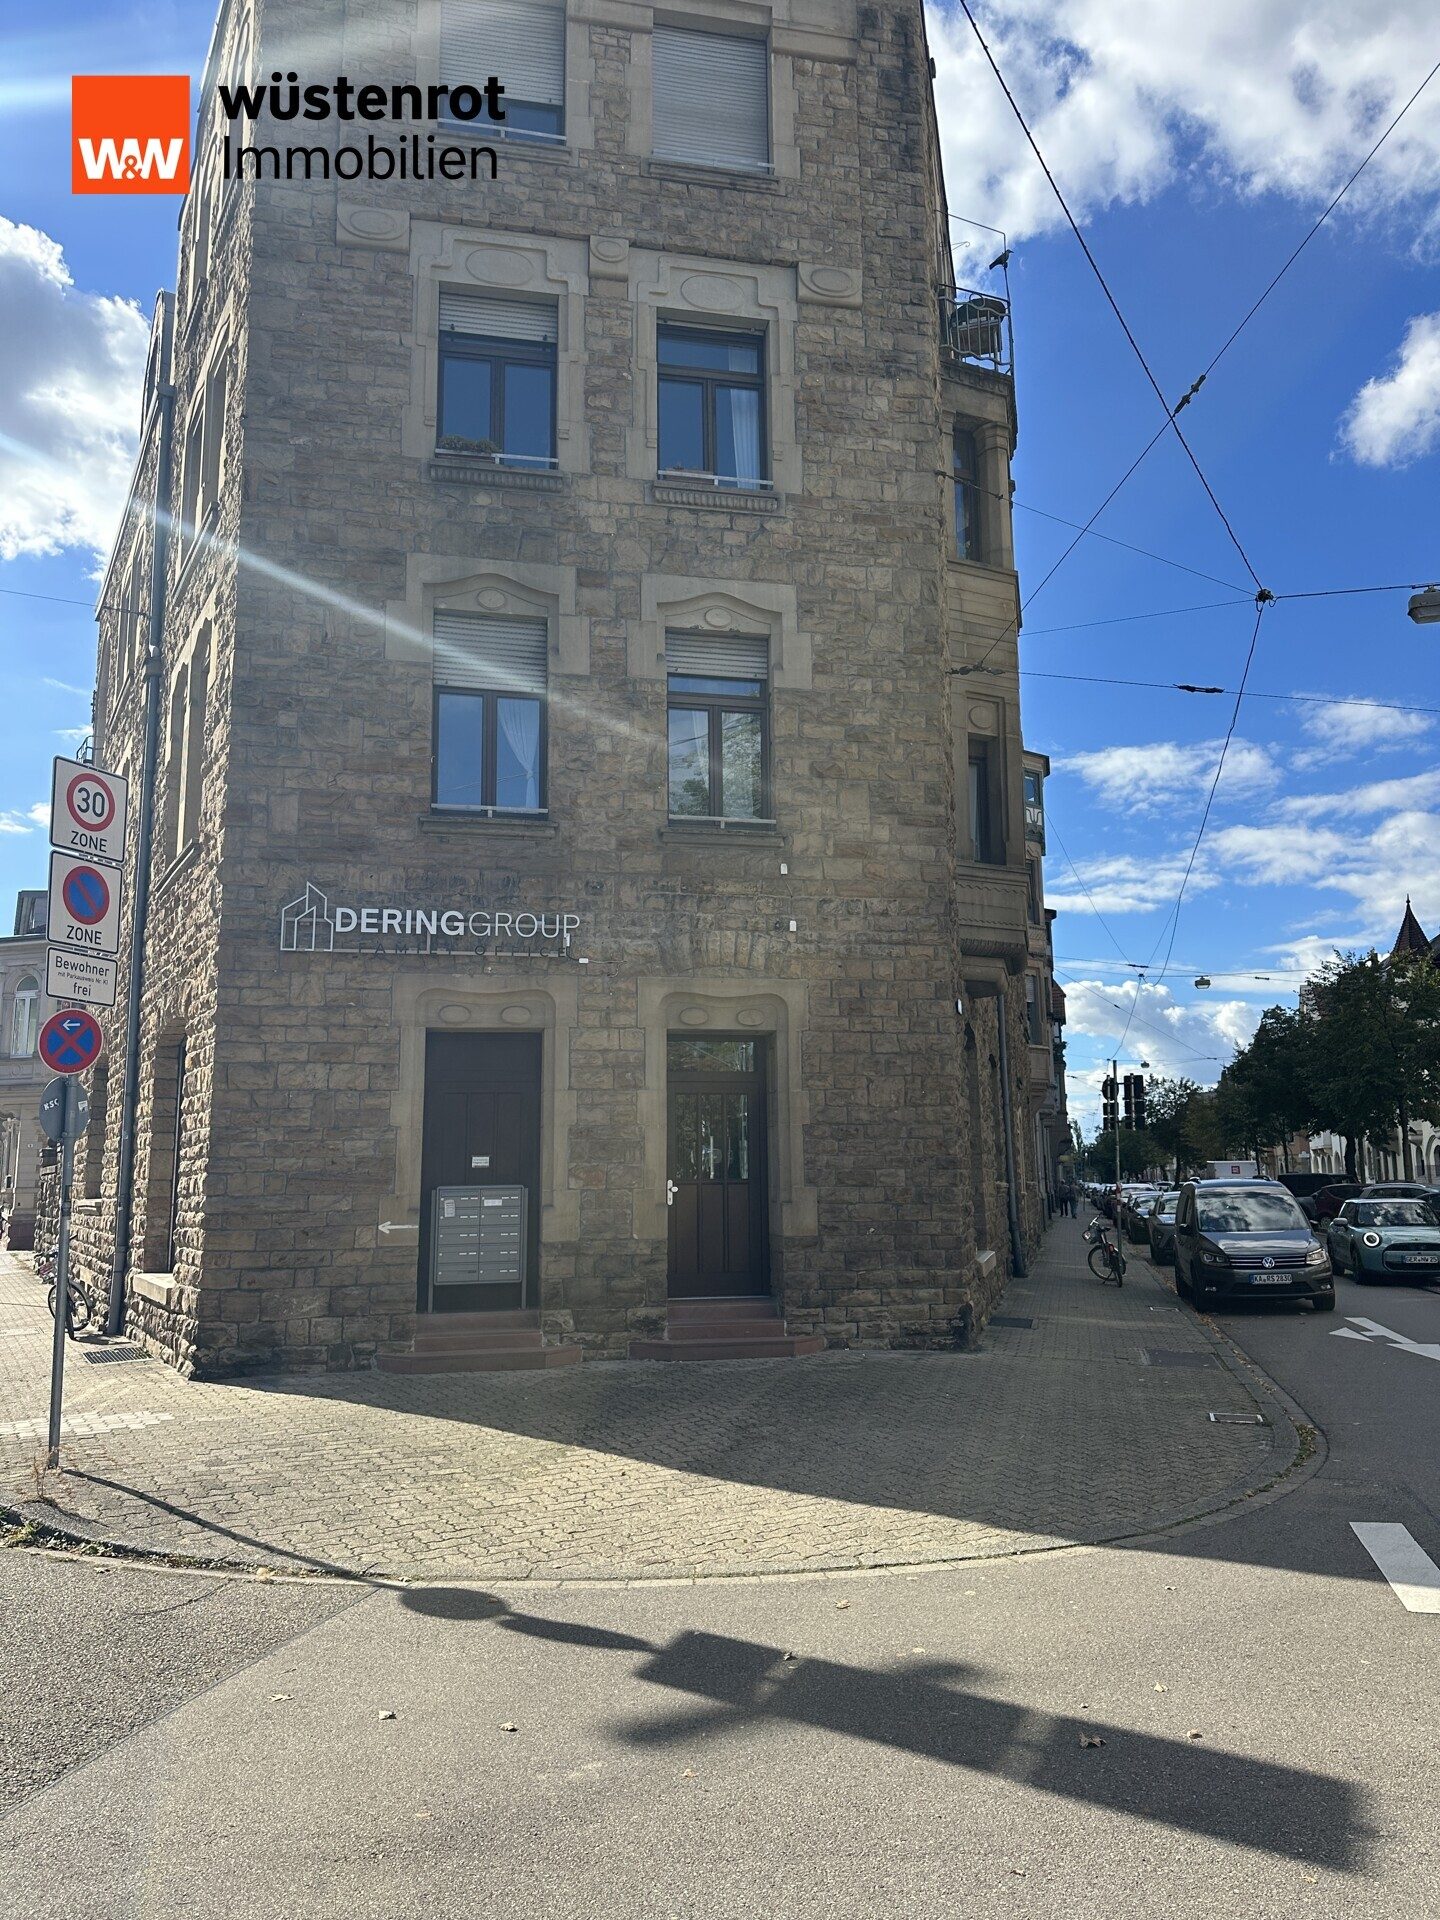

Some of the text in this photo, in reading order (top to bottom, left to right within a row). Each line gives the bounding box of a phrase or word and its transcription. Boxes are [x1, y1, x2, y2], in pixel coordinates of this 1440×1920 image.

[77, 787, 106, 818] 30
[71, 830, 107, 853] ZONE
[66, 925, 102, 945] ZONE
[474, 945, 566, 958] OFFICE
[55, 955, 110, 977] Bewohner
[73, 982, 92, 997] frei
[43, 1098, 60, 1111] KSC
